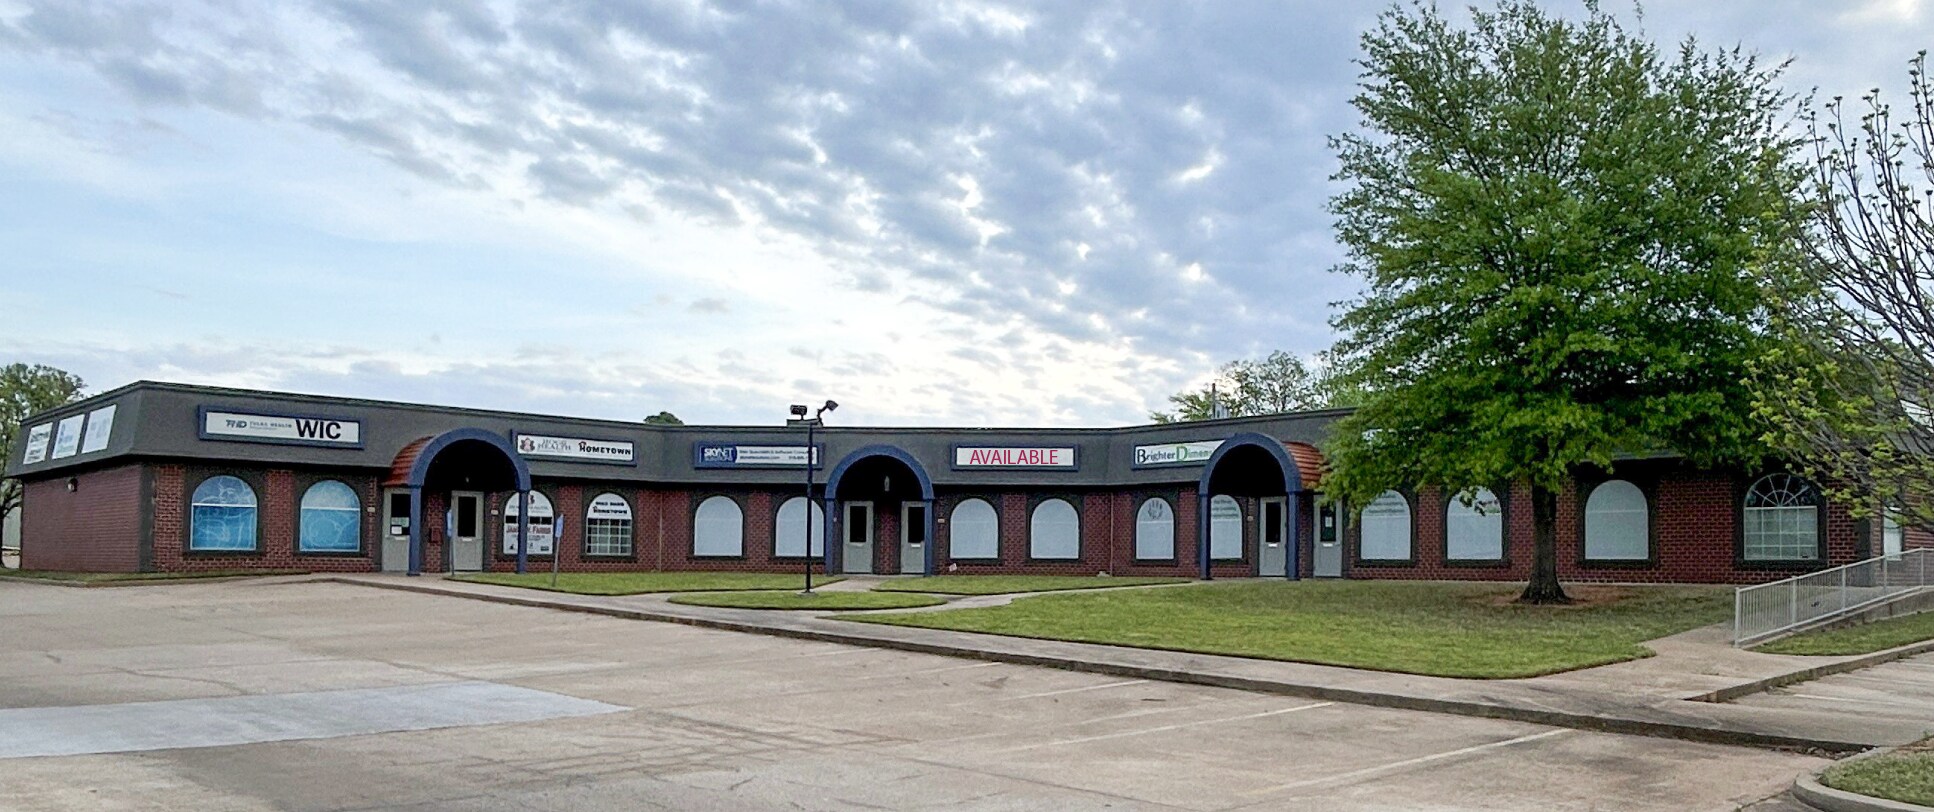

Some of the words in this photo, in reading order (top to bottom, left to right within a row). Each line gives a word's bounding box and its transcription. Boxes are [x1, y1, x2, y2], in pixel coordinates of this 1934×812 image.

[295, 419, 342, 440] WIC
[578, 441, 632, 455] HOMETOWN
[969, 449, 1059, 465] AVAILABLE
[1137, 449, 1176, 463] Brighter
